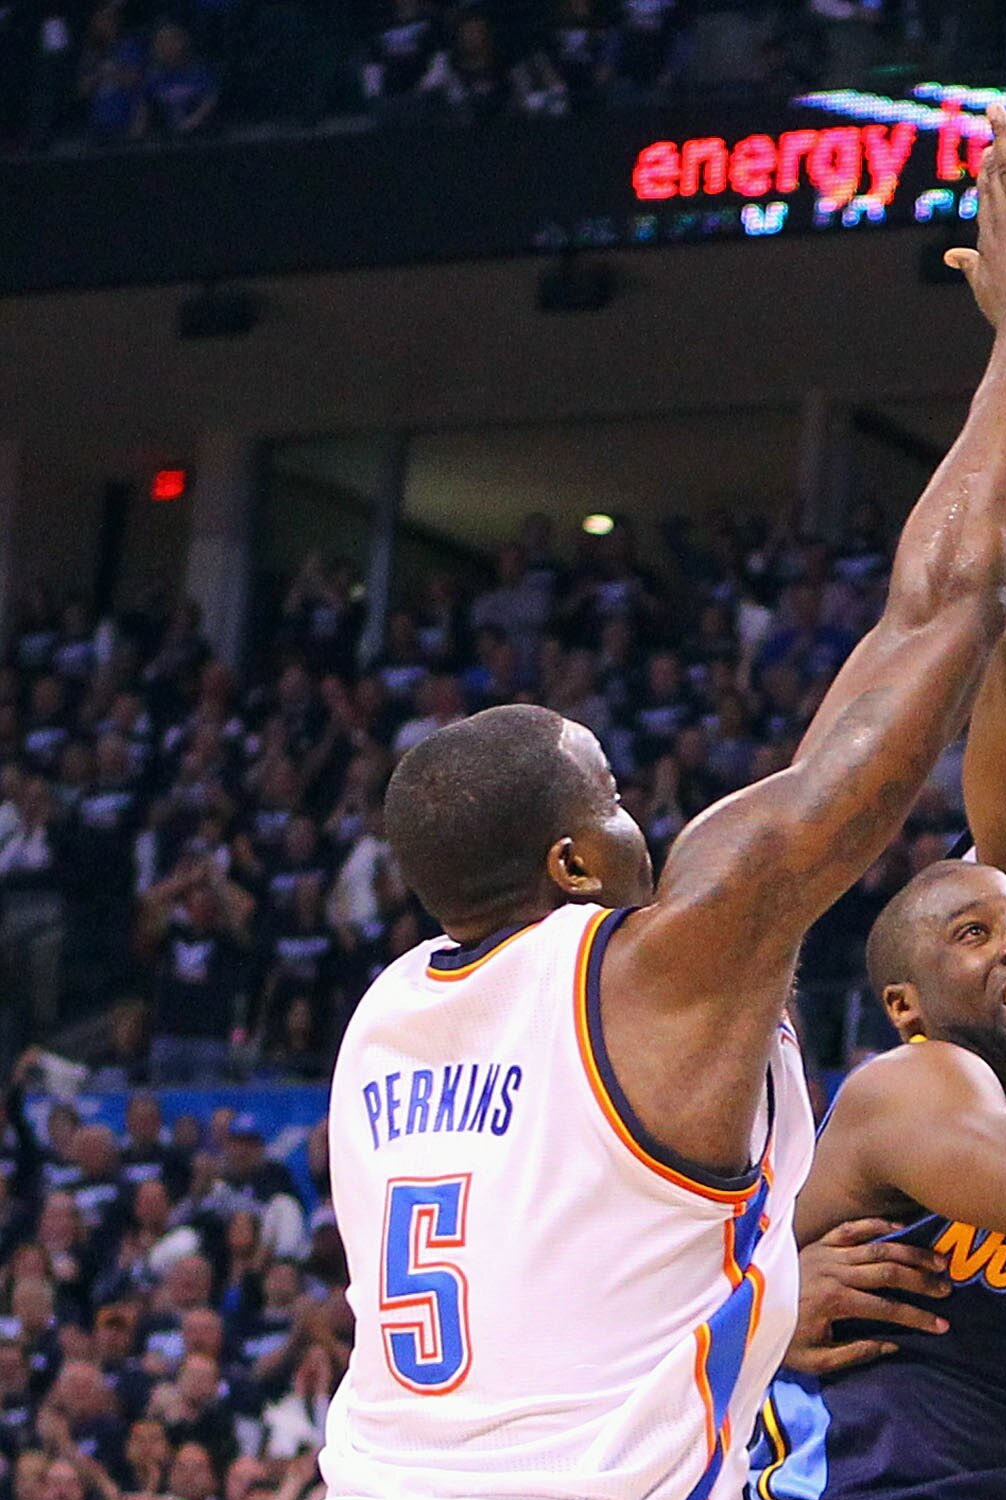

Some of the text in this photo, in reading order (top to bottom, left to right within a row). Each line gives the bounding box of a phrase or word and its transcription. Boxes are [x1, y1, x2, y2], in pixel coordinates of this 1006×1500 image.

[632, 123, 917, 206] energy
[363, 1063, 522, 1150] PERKINS
[380, 1172, 473, 1396] 5
